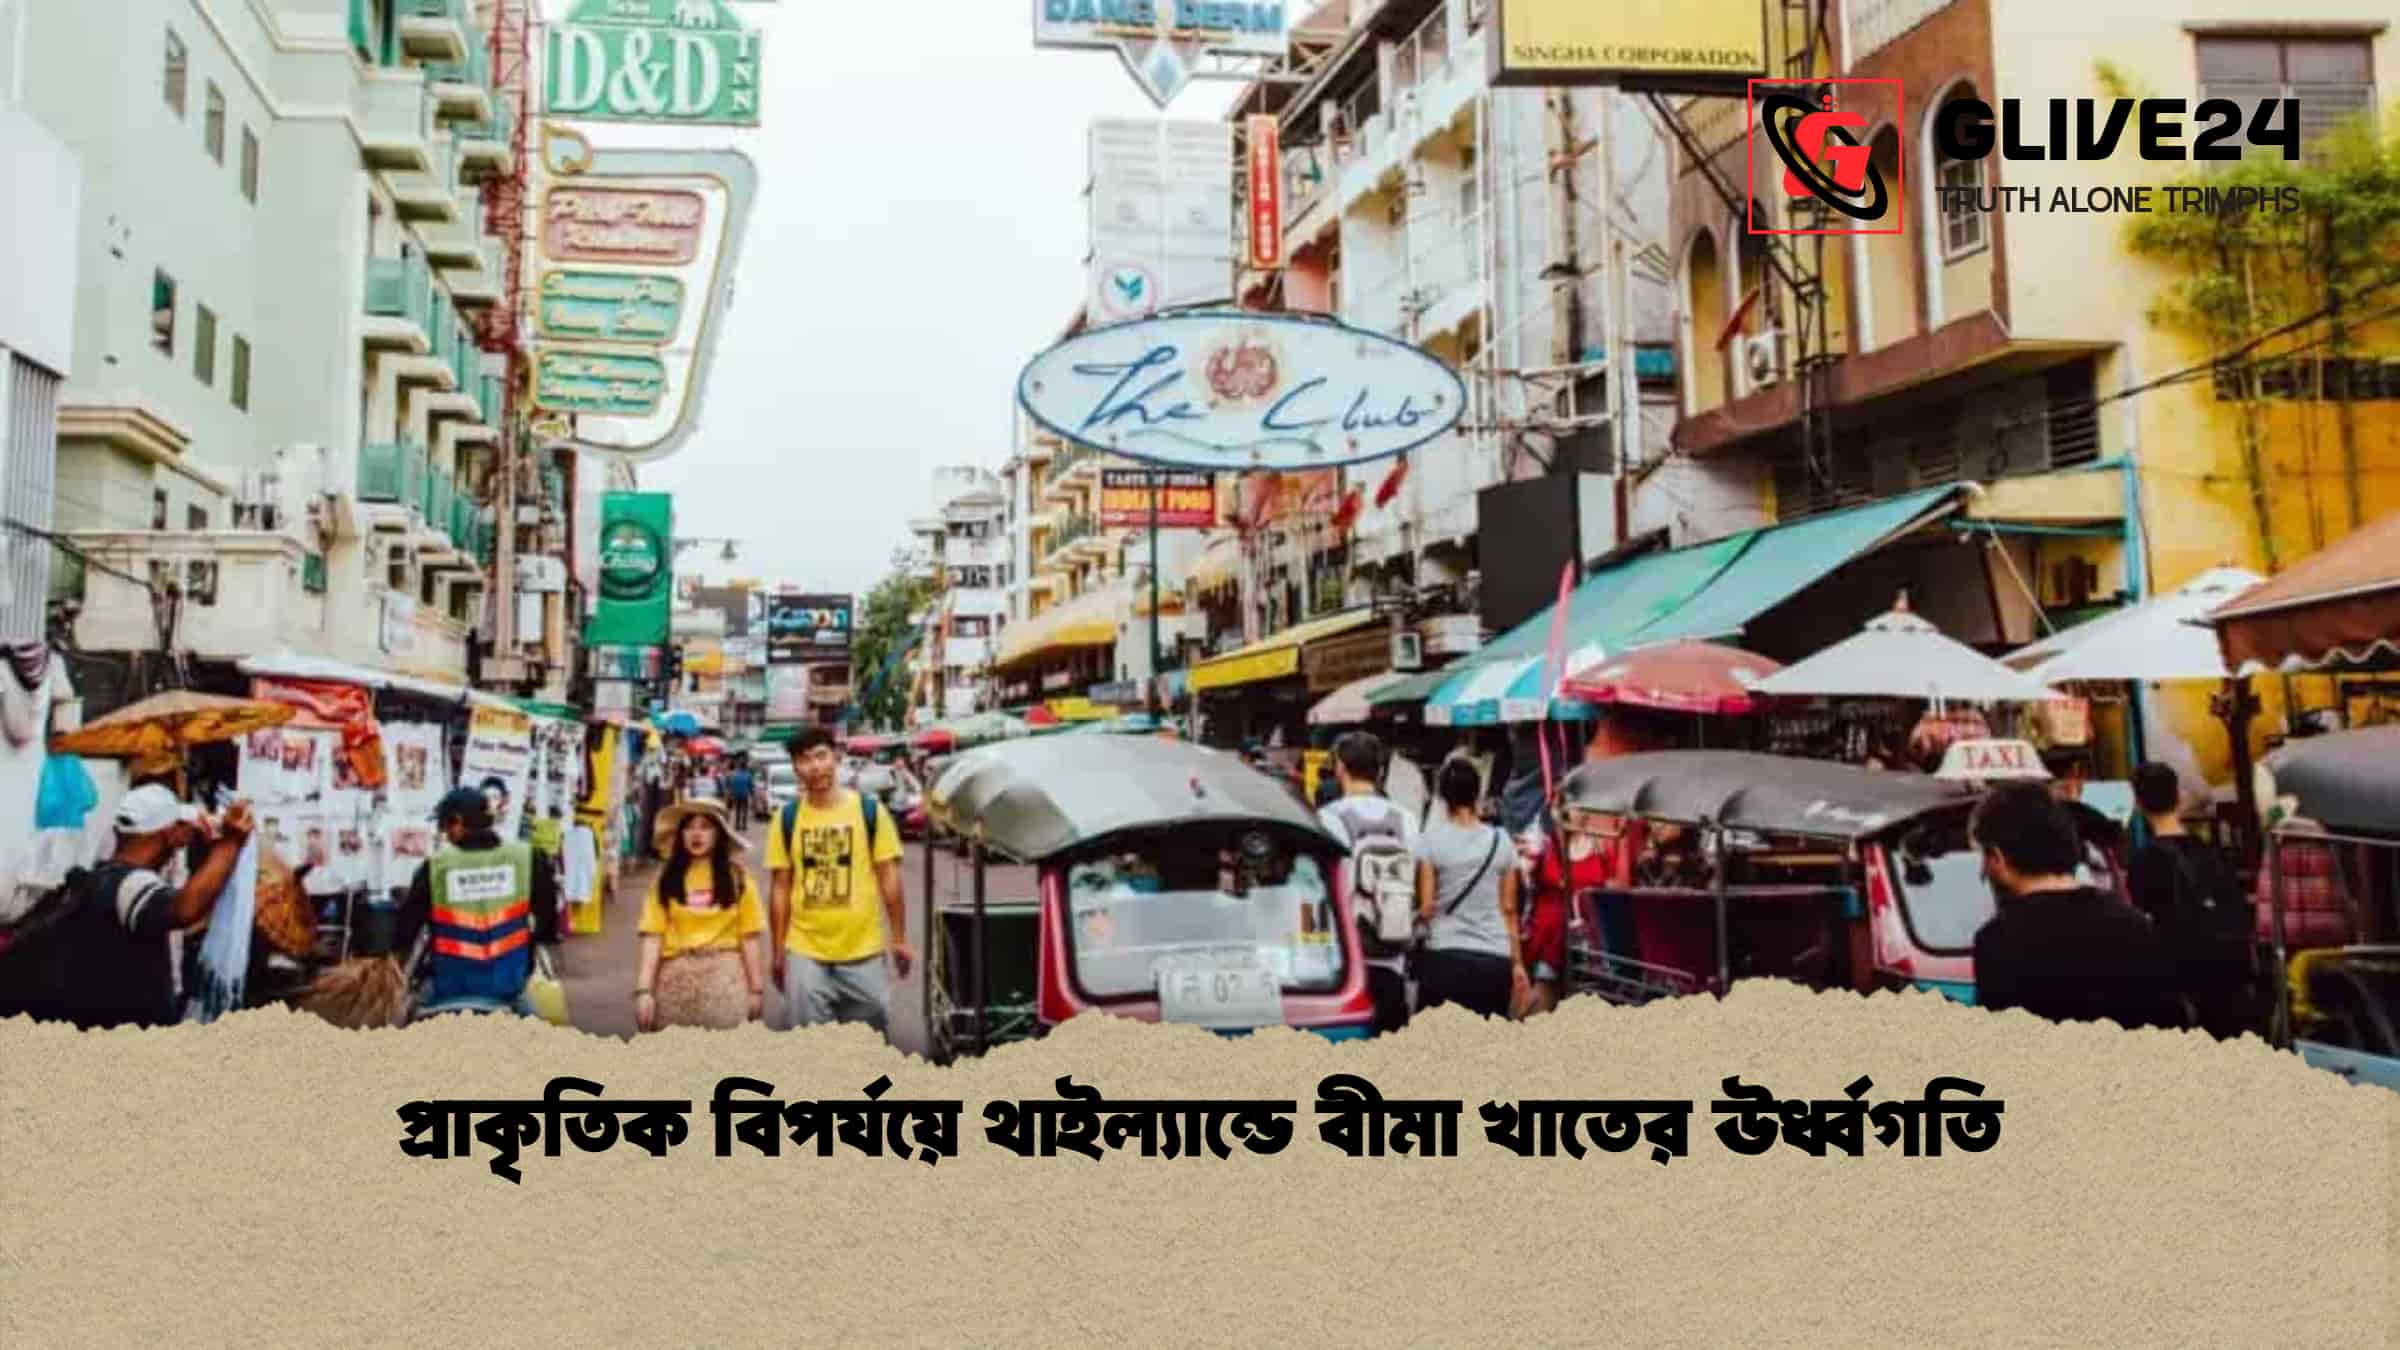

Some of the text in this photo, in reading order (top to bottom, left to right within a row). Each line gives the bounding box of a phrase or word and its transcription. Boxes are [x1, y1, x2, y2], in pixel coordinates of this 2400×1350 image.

[550, 27, 720, 115] D&D
[732, 32, 755, 112] INN
[1513, 44, 1757, 66] SINGHA CORPORATION
[1072, 345, 1432, 434] The Club
[1964, 745, 2026, 769] TAXI
